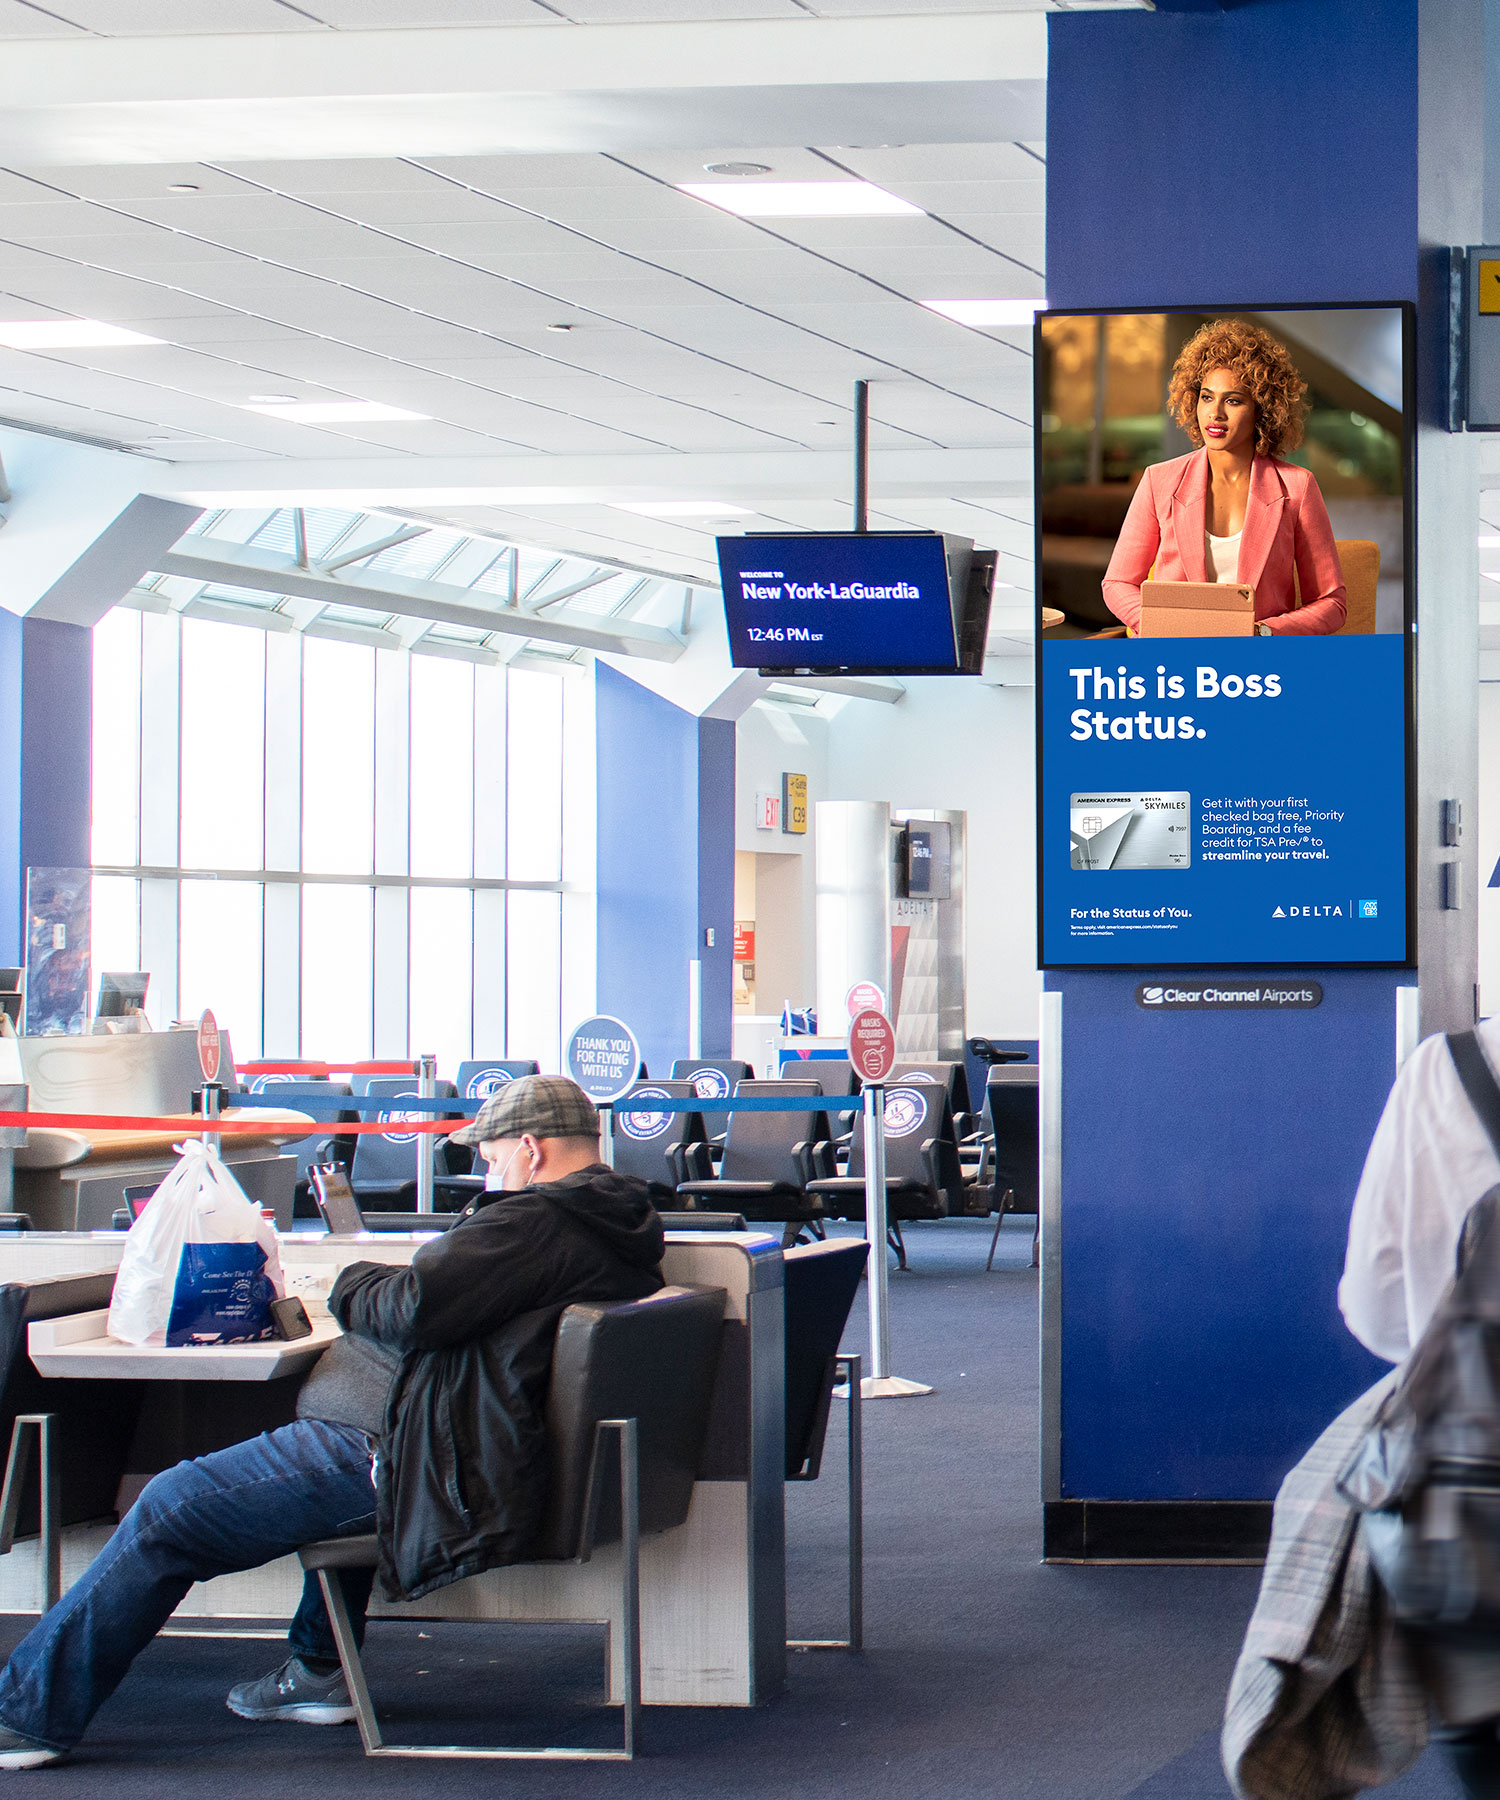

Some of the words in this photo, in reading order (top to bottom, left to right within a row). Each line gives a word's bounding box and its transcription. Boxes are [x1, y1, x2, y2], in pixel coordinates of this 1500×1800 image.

[739, 571, 773, 579] WELCOME
[742, 583, 782, 600] New
[784, 582, 920, 600] York-LaGuardia
[747, 628, 785, 641] 12:46
[786, 628, 811, 641] PM
[811, 633, 823, 641] EST
[1069, 666, 1147, 701] This
[1156, 665, 1186, 699] is
[1196, 666, 1283, 699] Boss
[1069, 708, 1207, 741] Status.
[1145, 802, 1186, 810] SKYMILES
[1202, 798, 1222, 808] Get
[1225, 798, 1232, 808] it
[1234, 797, 1258, 808] with
[1260, 799, 1285, 810] your
[1287, 797, 1308, 808] first
[765, 797, 780, 827] EXIT
[793, 806, 806, 823] C39
[1202, 811, 1250, 822] checked
[1252, 811, 1275, 823] bag
[1277, 810, 1303, 822] free,
[1305, 810, 1345, 822] Priority
[1202, 824, 1256, 836] Boarding,
[1258, 824, 1280, 834] and
[1283, 826, 1291, 834] a
[1293, 823, 1312, 834] fee
[1202, 837, 1235, 847] credit
[1237, 836, 1253, 847] for
[1254, 837, 1276, 847] TSA
[1311, 837, 1323, 847] to
[1202, 850, 1262, 861] streamline
[1264, 851, 1291, 862] your
[1291, 849, 1330, 860] travel.
[904, 901, 928, 914] DELTA
[1070, 908, 1089, 919] For
[1090, 908, 1110, 918] the
[1112, 908, 1151, 918] Status
[1153, 907, 1166, 918] of
[1167, 907, 1193, 918] You.
[1290, 906, 1343, 917] DELTA
[1164, 988, 1202, 1002] Clear
[1202, 988, 1260, 1002] Channel
[1262, 988, 1313, 1004] Airports
[861, 1018, 881, 1028] MASKS
[857, 1029, 886, 1039] REQUIRED
[575, 1036, 609, 1051] THANK
[610, 1039, 631, 1053] YOU
[576, 1050, 596, 1063] FOR
[597, 1051, 630, 1066] FLYING
[582, 1063, 608, 1077] WITH
[609, 1066, 623, 1078] US
[203, 1271, 221, 1279] Come
